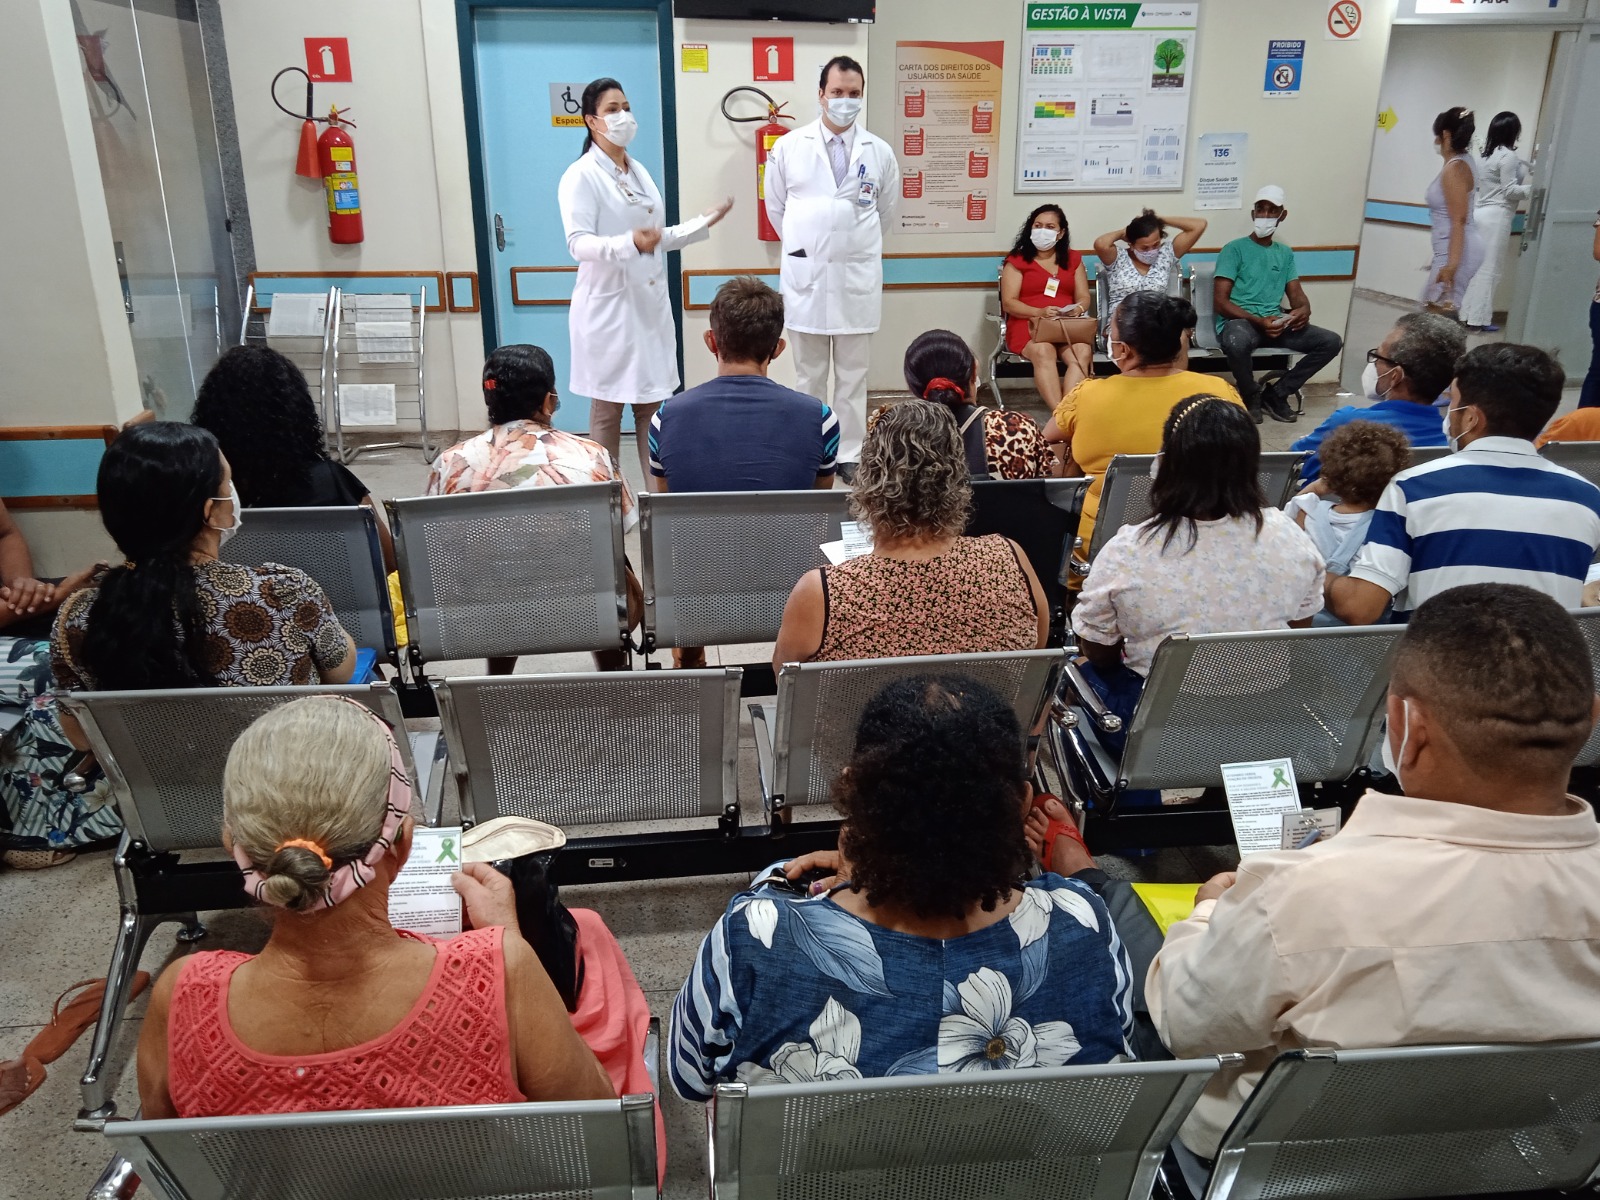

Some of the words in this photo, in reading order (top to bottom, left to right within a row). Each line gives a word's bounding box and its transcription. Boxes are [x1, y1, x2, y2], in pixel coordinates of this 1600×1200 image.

[1031, 6, 1078, 20] GESTÃO
[1080, 6, 1090, 20] À
[1094, 8, 1127, 20] VISTA
[908, 72, 944, 80] USUÁRIOS
[957, 72, 982, 80] SAÚDE
[1214, 148, 1229, 157] 136
